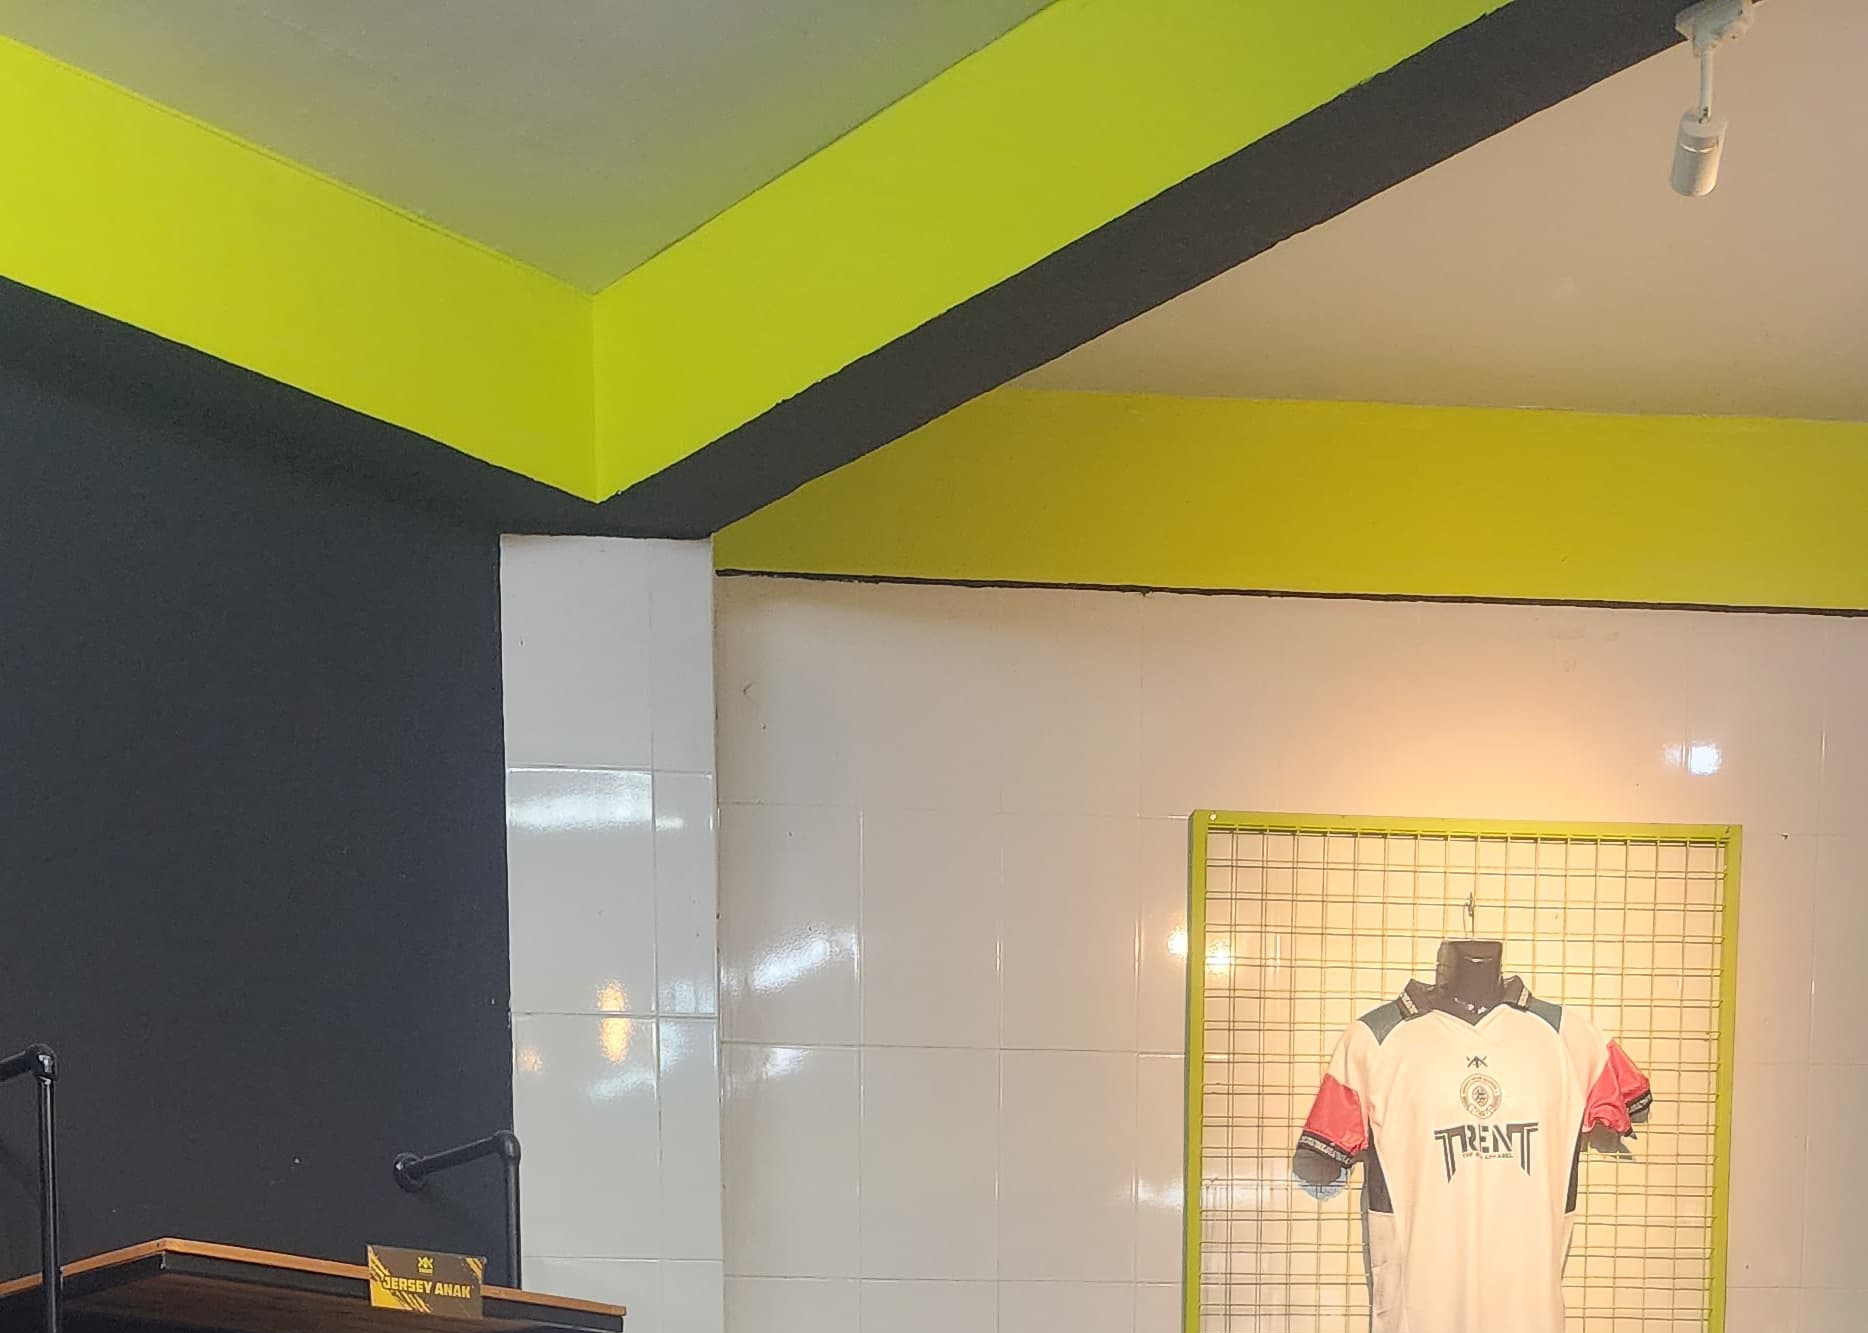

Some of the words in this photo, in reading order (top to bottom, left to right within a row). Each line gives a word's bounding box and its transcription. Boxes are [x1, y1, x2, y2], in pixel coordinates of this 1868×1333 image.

[1433, 1121, 1539, 1184] TRENT
[382, 1276, 432, 1294] JERSEY
[434, 1282, 471, 1299] ANAK
